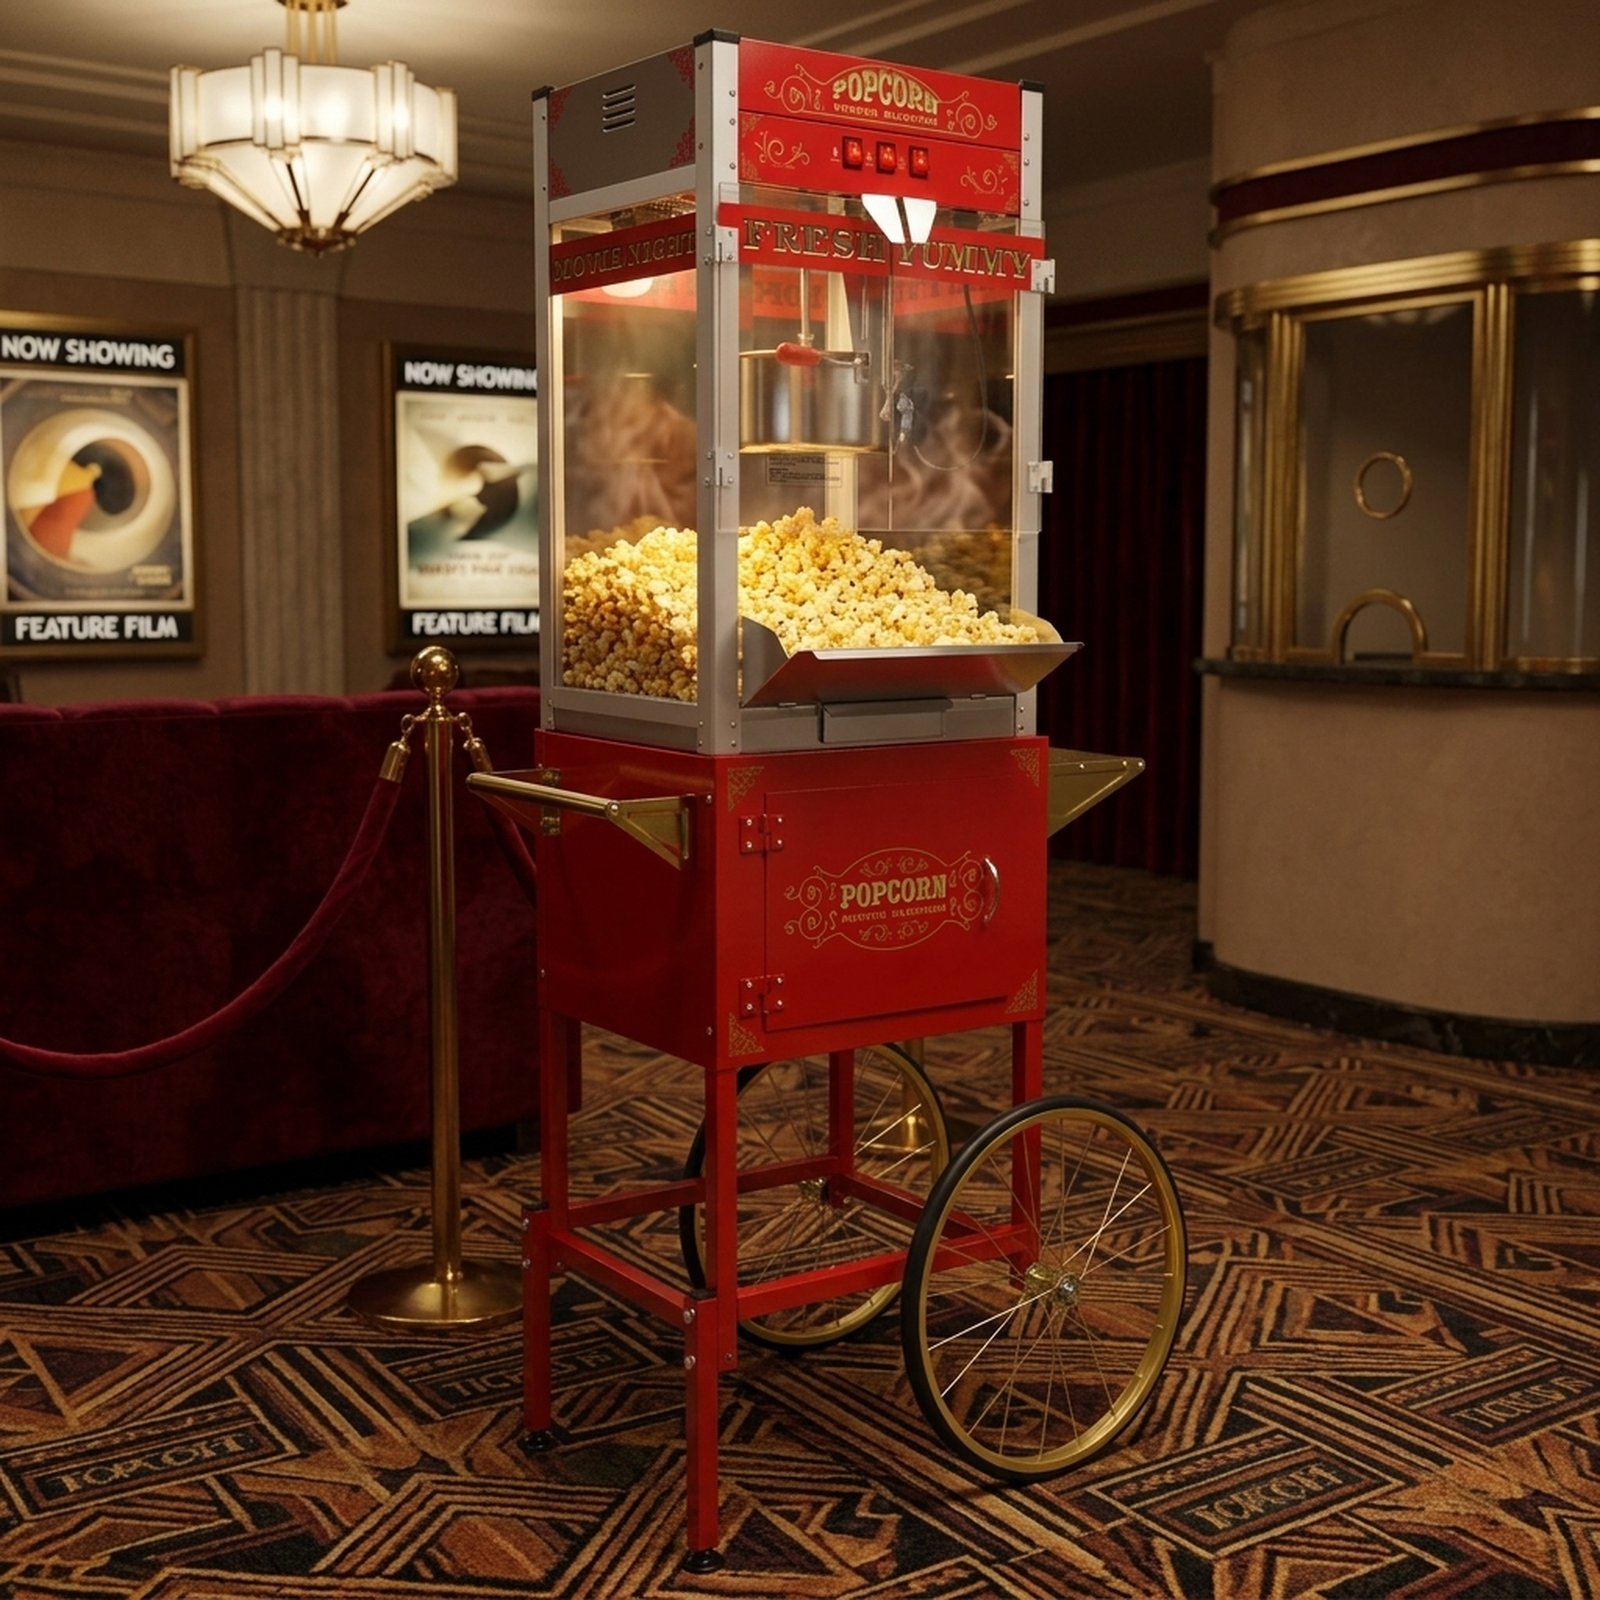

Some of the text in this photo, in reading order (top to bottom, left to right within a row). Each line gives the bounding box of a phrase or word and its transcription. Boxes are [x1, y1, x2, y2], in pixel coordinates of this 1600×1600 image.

[743, 218, 1031, 279] FRESH YUMMY
[1, 335, 175, 369] NOW SHOWING
[404, 361, 454, 386] NOW
[15, 615, 178, 640] FEATURE FILM
[412, 611, 498, 635] FEATURE
[840, 875, 947, 909] POPCORN
